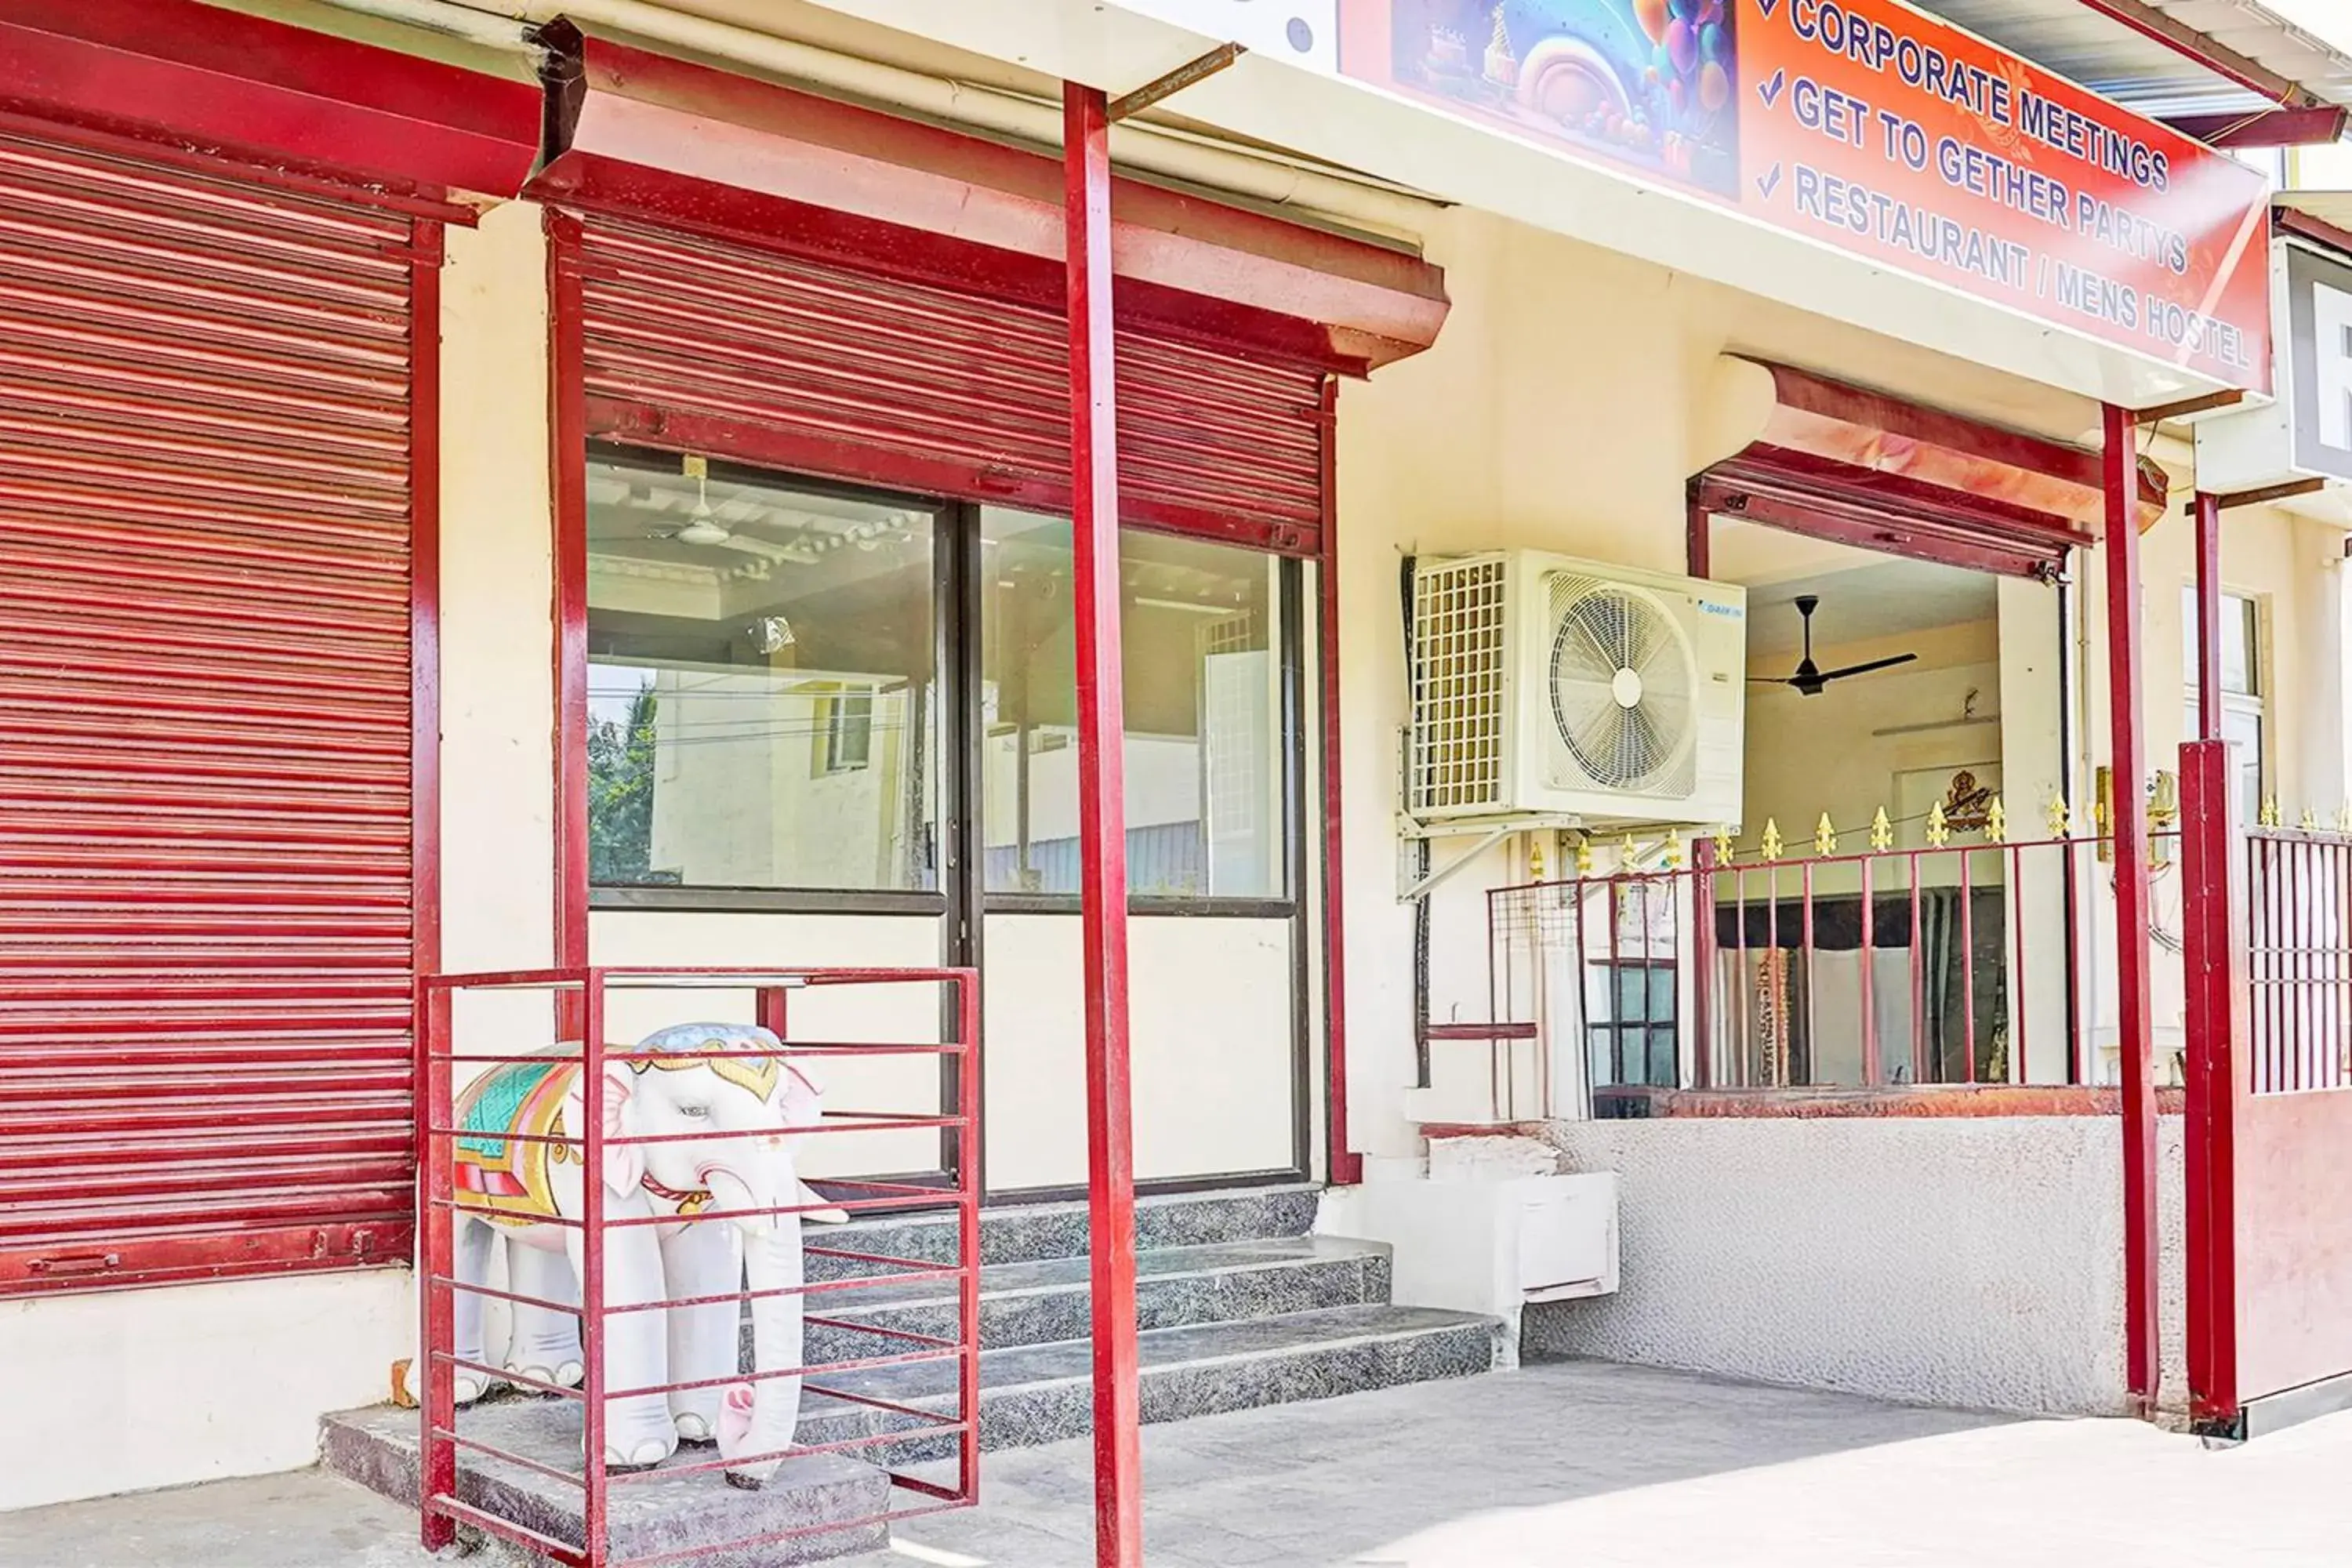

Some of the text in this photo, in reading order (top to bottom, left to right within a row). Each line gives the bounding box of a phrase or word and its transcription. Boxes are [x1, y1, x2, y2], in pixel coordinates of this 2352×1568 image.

[1790, 0, 2169, 193] CORPORATE MEETINGS
[1792, 78, 2187, 274] GET TO GETHER PARTYS
[1794, 164, 2029, 289] RESTAURANT
[2038, 255, 2048, 297] /
[2056, 262, 2138, 330] MENS
[2147, 295, 2251, 368] HOSTEL
